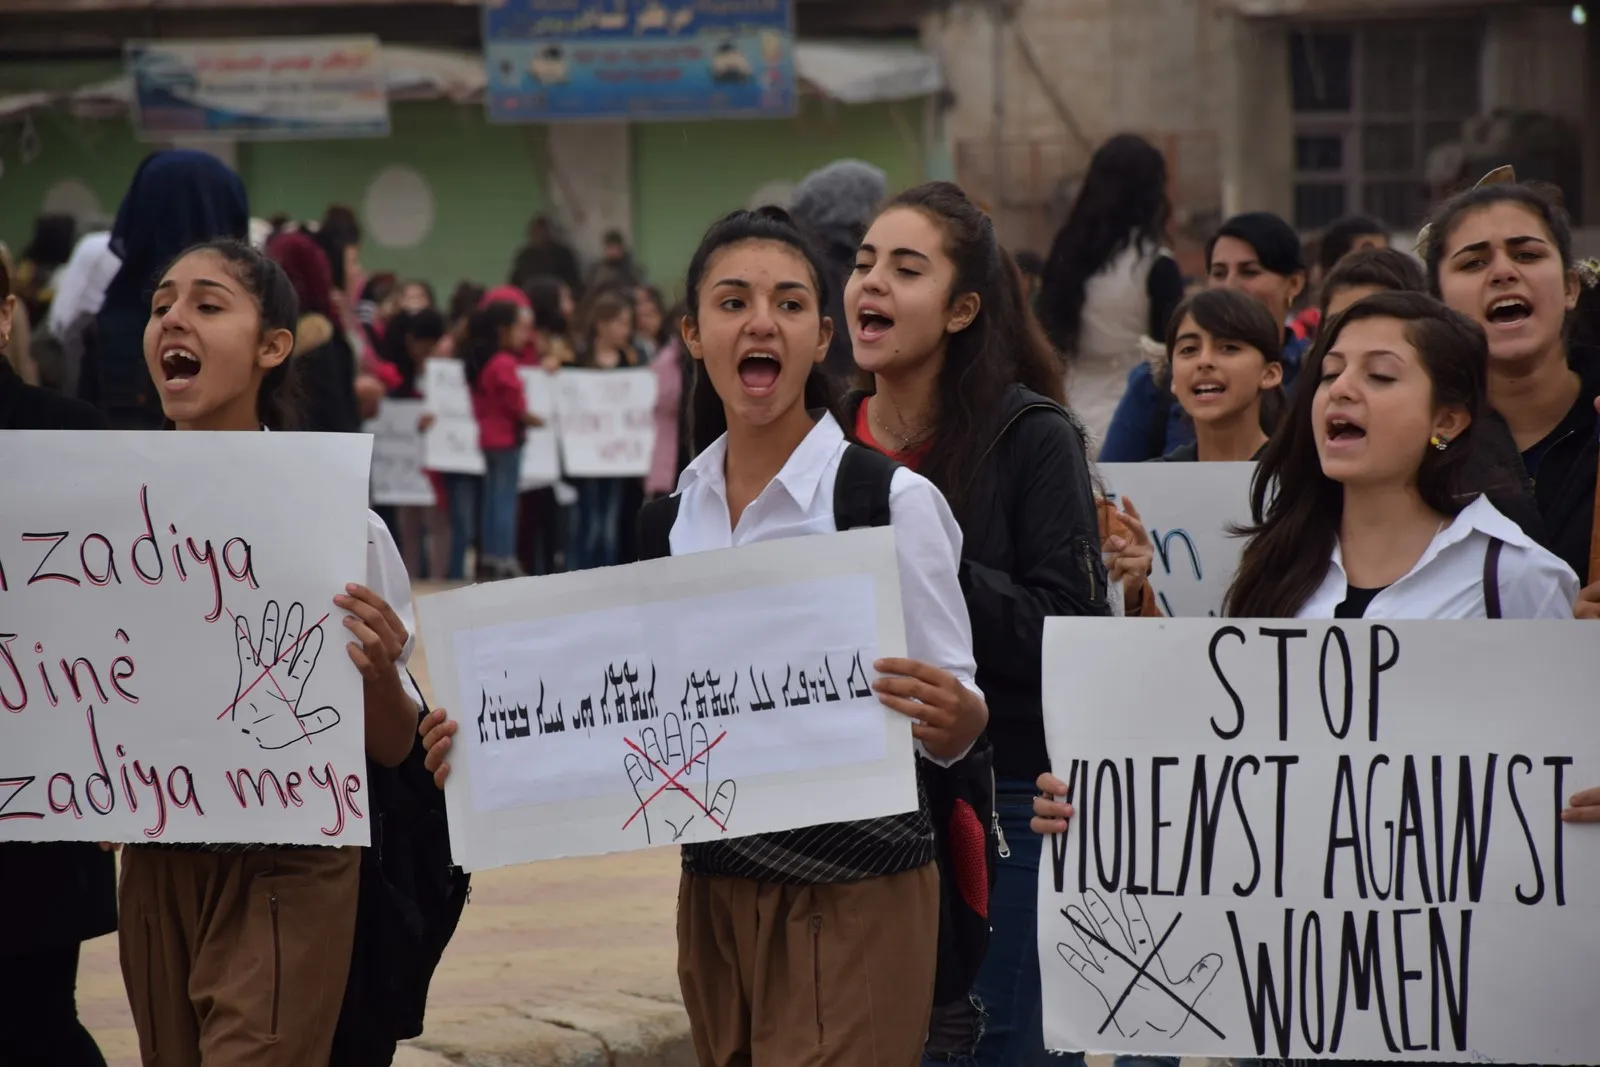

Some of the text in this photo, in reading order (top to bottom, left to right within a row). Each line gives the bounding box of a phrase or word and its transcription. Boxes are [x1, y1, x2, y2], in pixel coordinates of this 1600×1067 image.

[0, 483, 259, 622] zadiya
[1208, 624, 1400, 742] STOP
[225, 761, 364, 837] meye
[1049, 753, 1574, 906] VIOLENST AGAINST
[1226, 907, 1473, 1058] WOMEN
